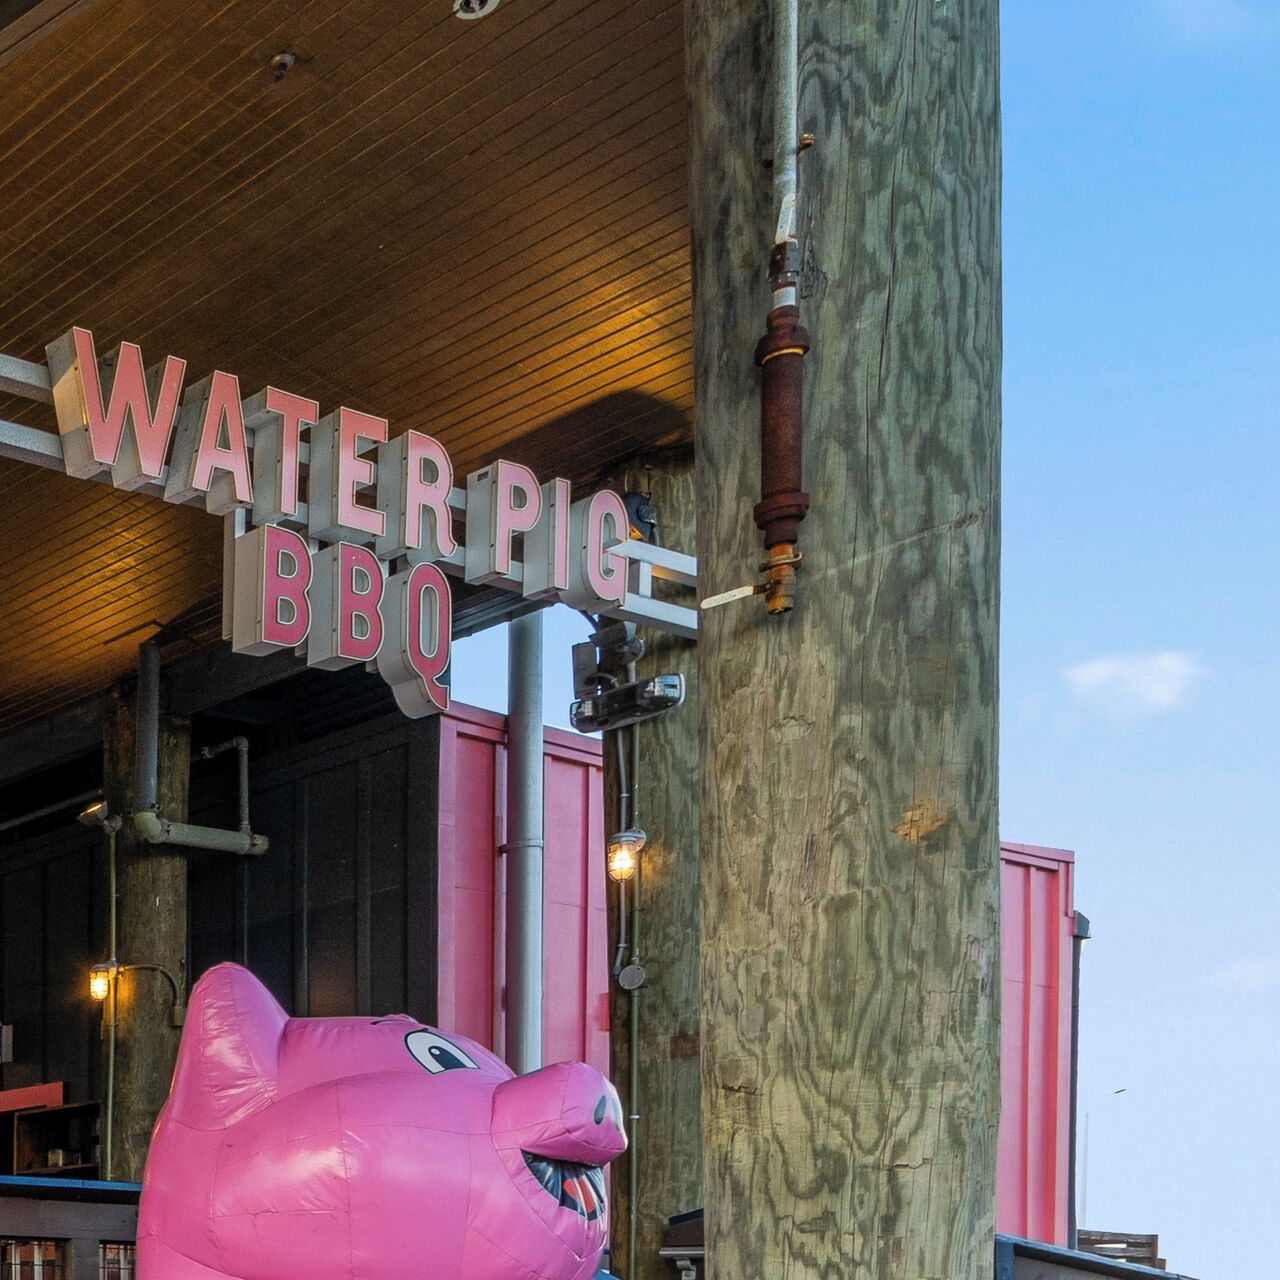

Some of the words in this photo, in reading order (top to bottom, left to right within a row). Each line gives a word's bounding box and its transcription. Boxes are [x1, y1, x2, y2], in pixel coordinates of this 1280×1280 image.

[72, 326, 458, 557] WATER
[495, 459, 630, 606] PIG
[261, 523, 451, 712] BBQ
